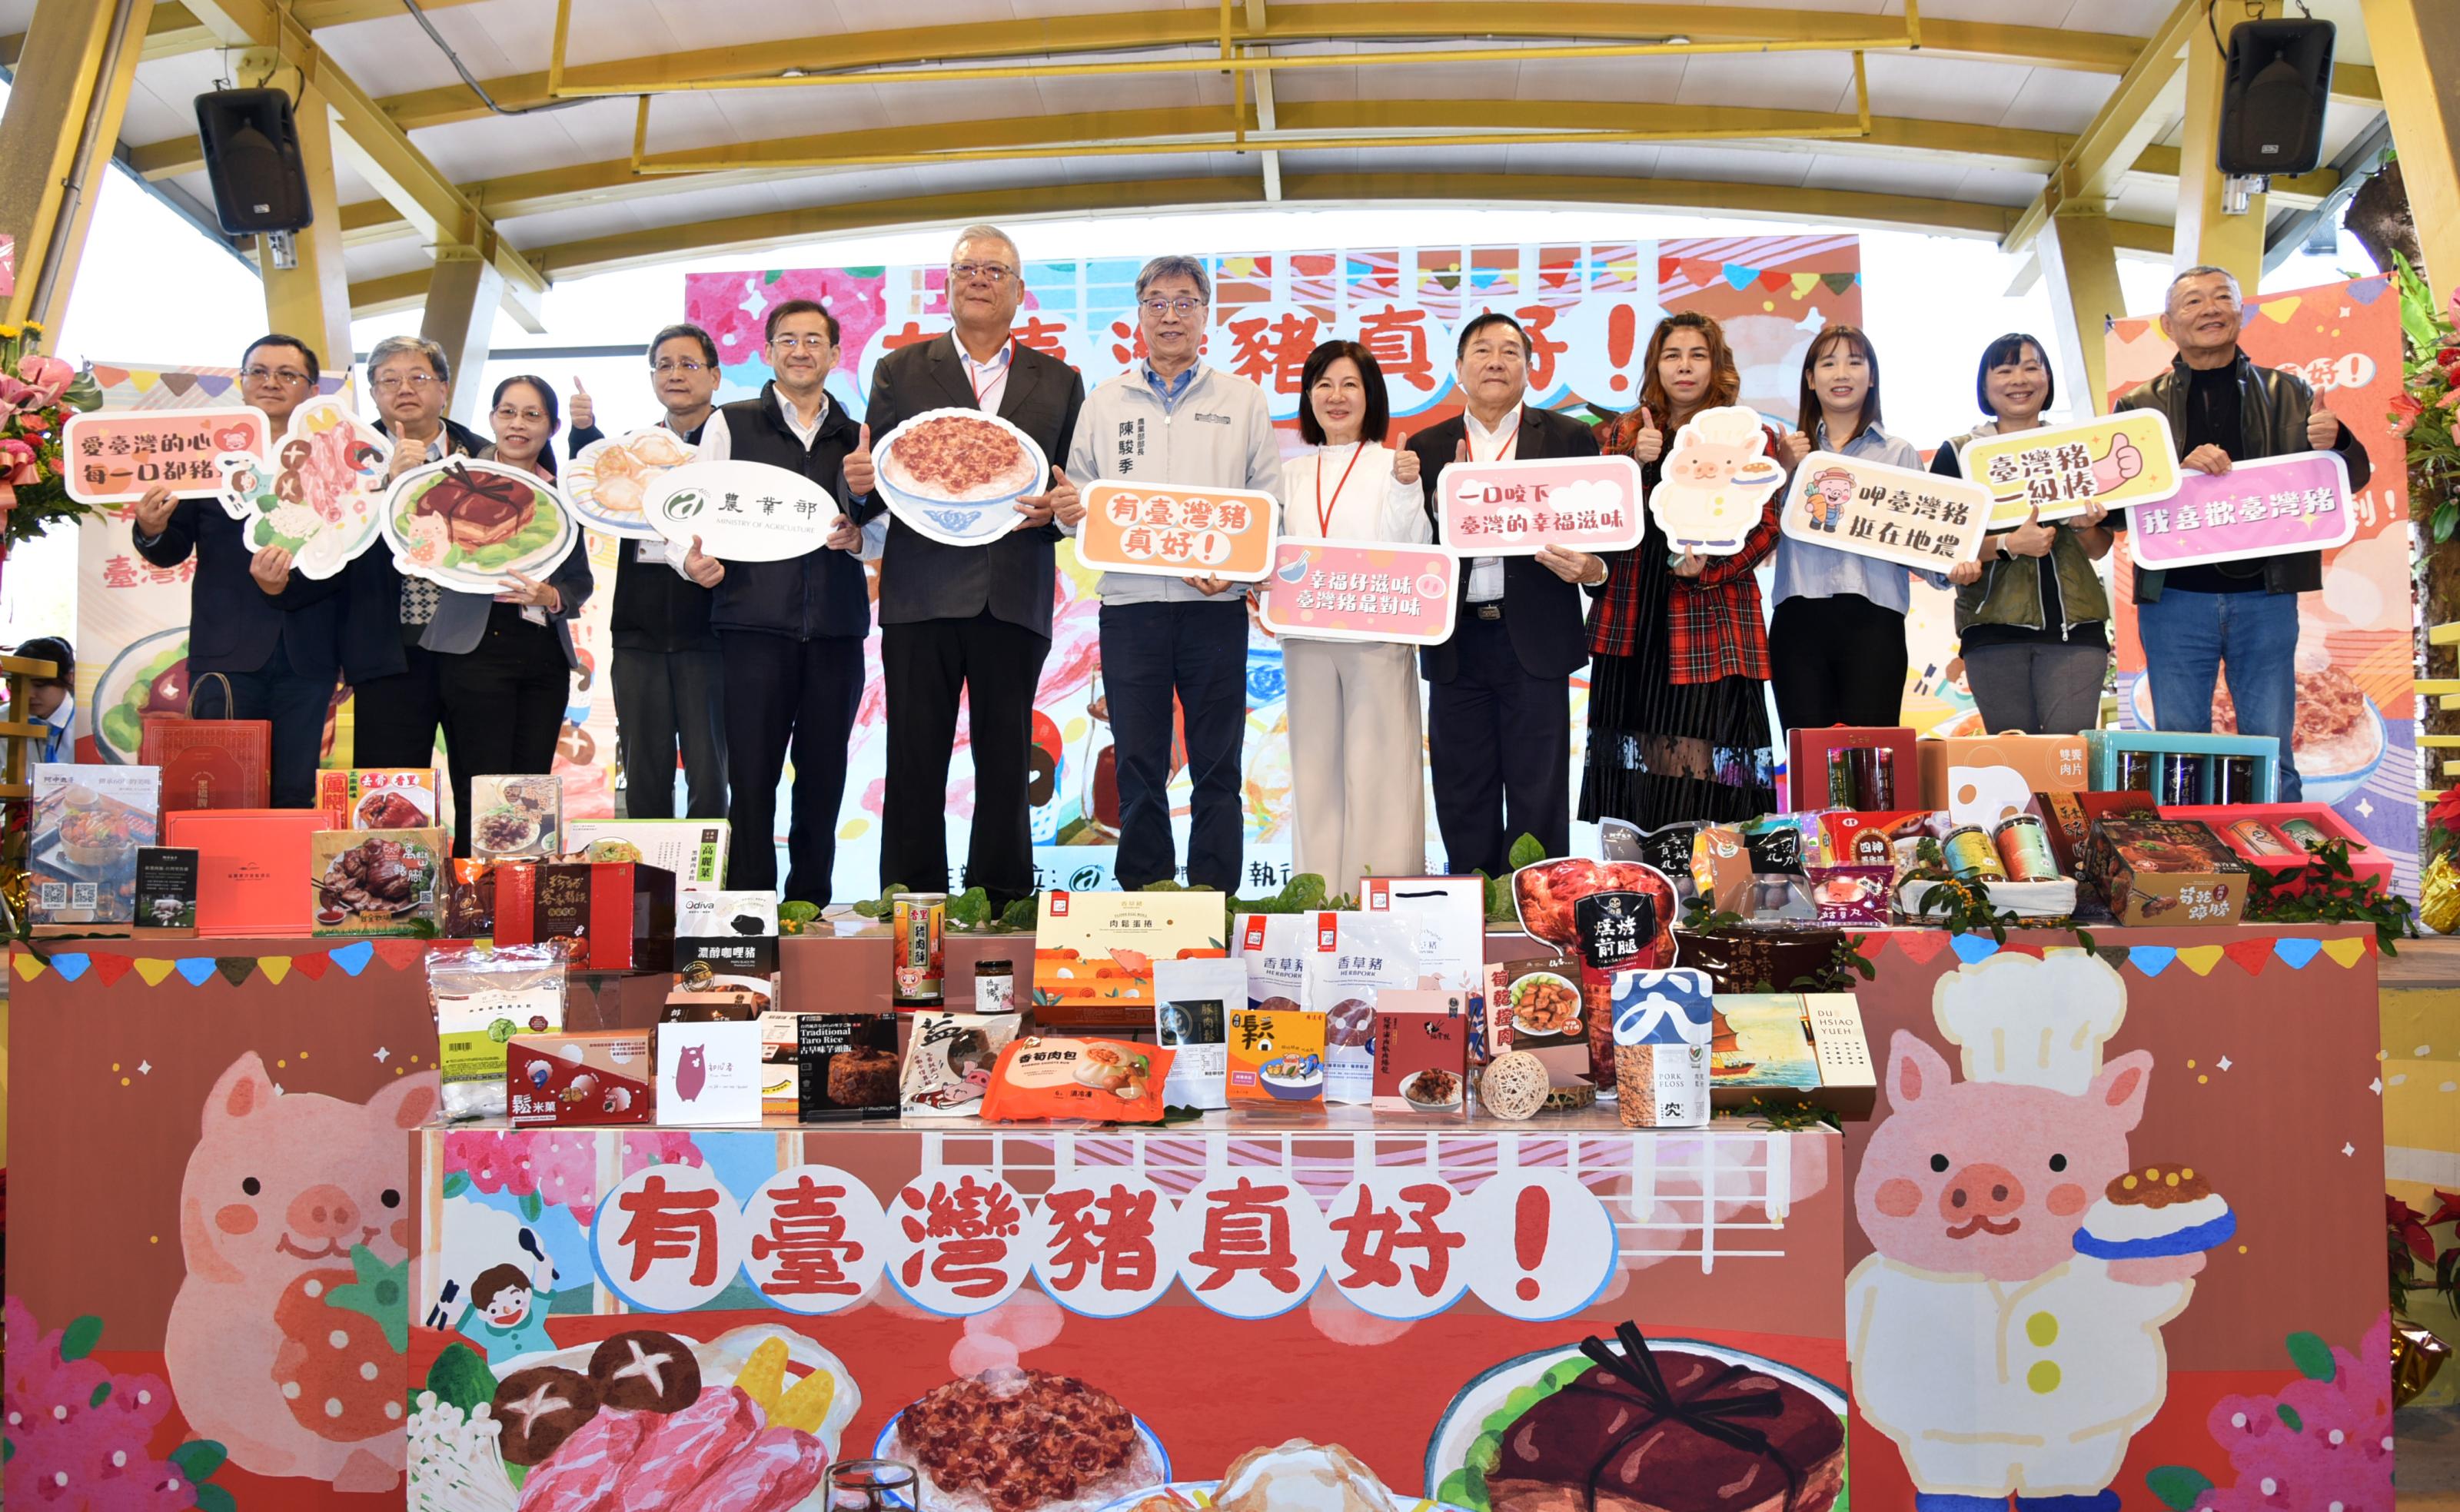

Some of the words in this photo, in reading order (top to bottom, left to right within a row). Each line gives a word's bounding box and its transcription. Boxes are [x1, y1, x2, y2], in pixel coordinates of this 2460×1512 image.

[81, 433, 211, 456] 愛臺灣的心
[1119, 420, 1134, 474] 陳駿季
[83, 460, 222, 484] 每一口都豬
[1990, 444, 2089, 483] 臺灣豬
[1458, 484, 1550, 503] 一口咬下
[1994, 470, 2097, 505] 一級棒
[718, 492, 818, 520] 農業部
[1112, 495, 1246, 529] 有臺灣豬
[1859, 486, 1970, 525] 呷臺灣豬
[2142, 487, 2336, 534] 我喜歡臺灣豬
[716, 518, 750, 527] MINISTRY
[765, 523, 815, 533] AGRICULTURE
[1460, 509, 1624, 535] 臺灣的幸福滋味
[1125, 527, 1215, 560] 真好！
[1849, 515, 1960, 559] 挺在地農
[1309, 570, 1412, 595] 幸福好滋味
[1296, 590, 1421, 616] 臺灣豬最對味
[361, 775, 387, 787] 去骨
[2059, 764, 2082, 776] 肉片
[701, 845, 713, 878] 高麗菜
[910, 909, 929, 921] 香里
[1109, 919, 1153, 929] 肉鬆蛋捲
[1594, 915, 1637, 936] 燻烤
[697, 946, 756, 959] 濃醇咖哩豬
[1594, 938, 1639, 958] 前腿
[1338, 955, 1383, 971] 香草豬
[800, 1028, 851, 1037] Traditional
[800, 1044, 853, 1055] 古早味芋頭飯
[1019, 1051, 1077, 1064] 香筍肉包
[617, 1175, 1551, 1301] 有臺灣豬真好！
